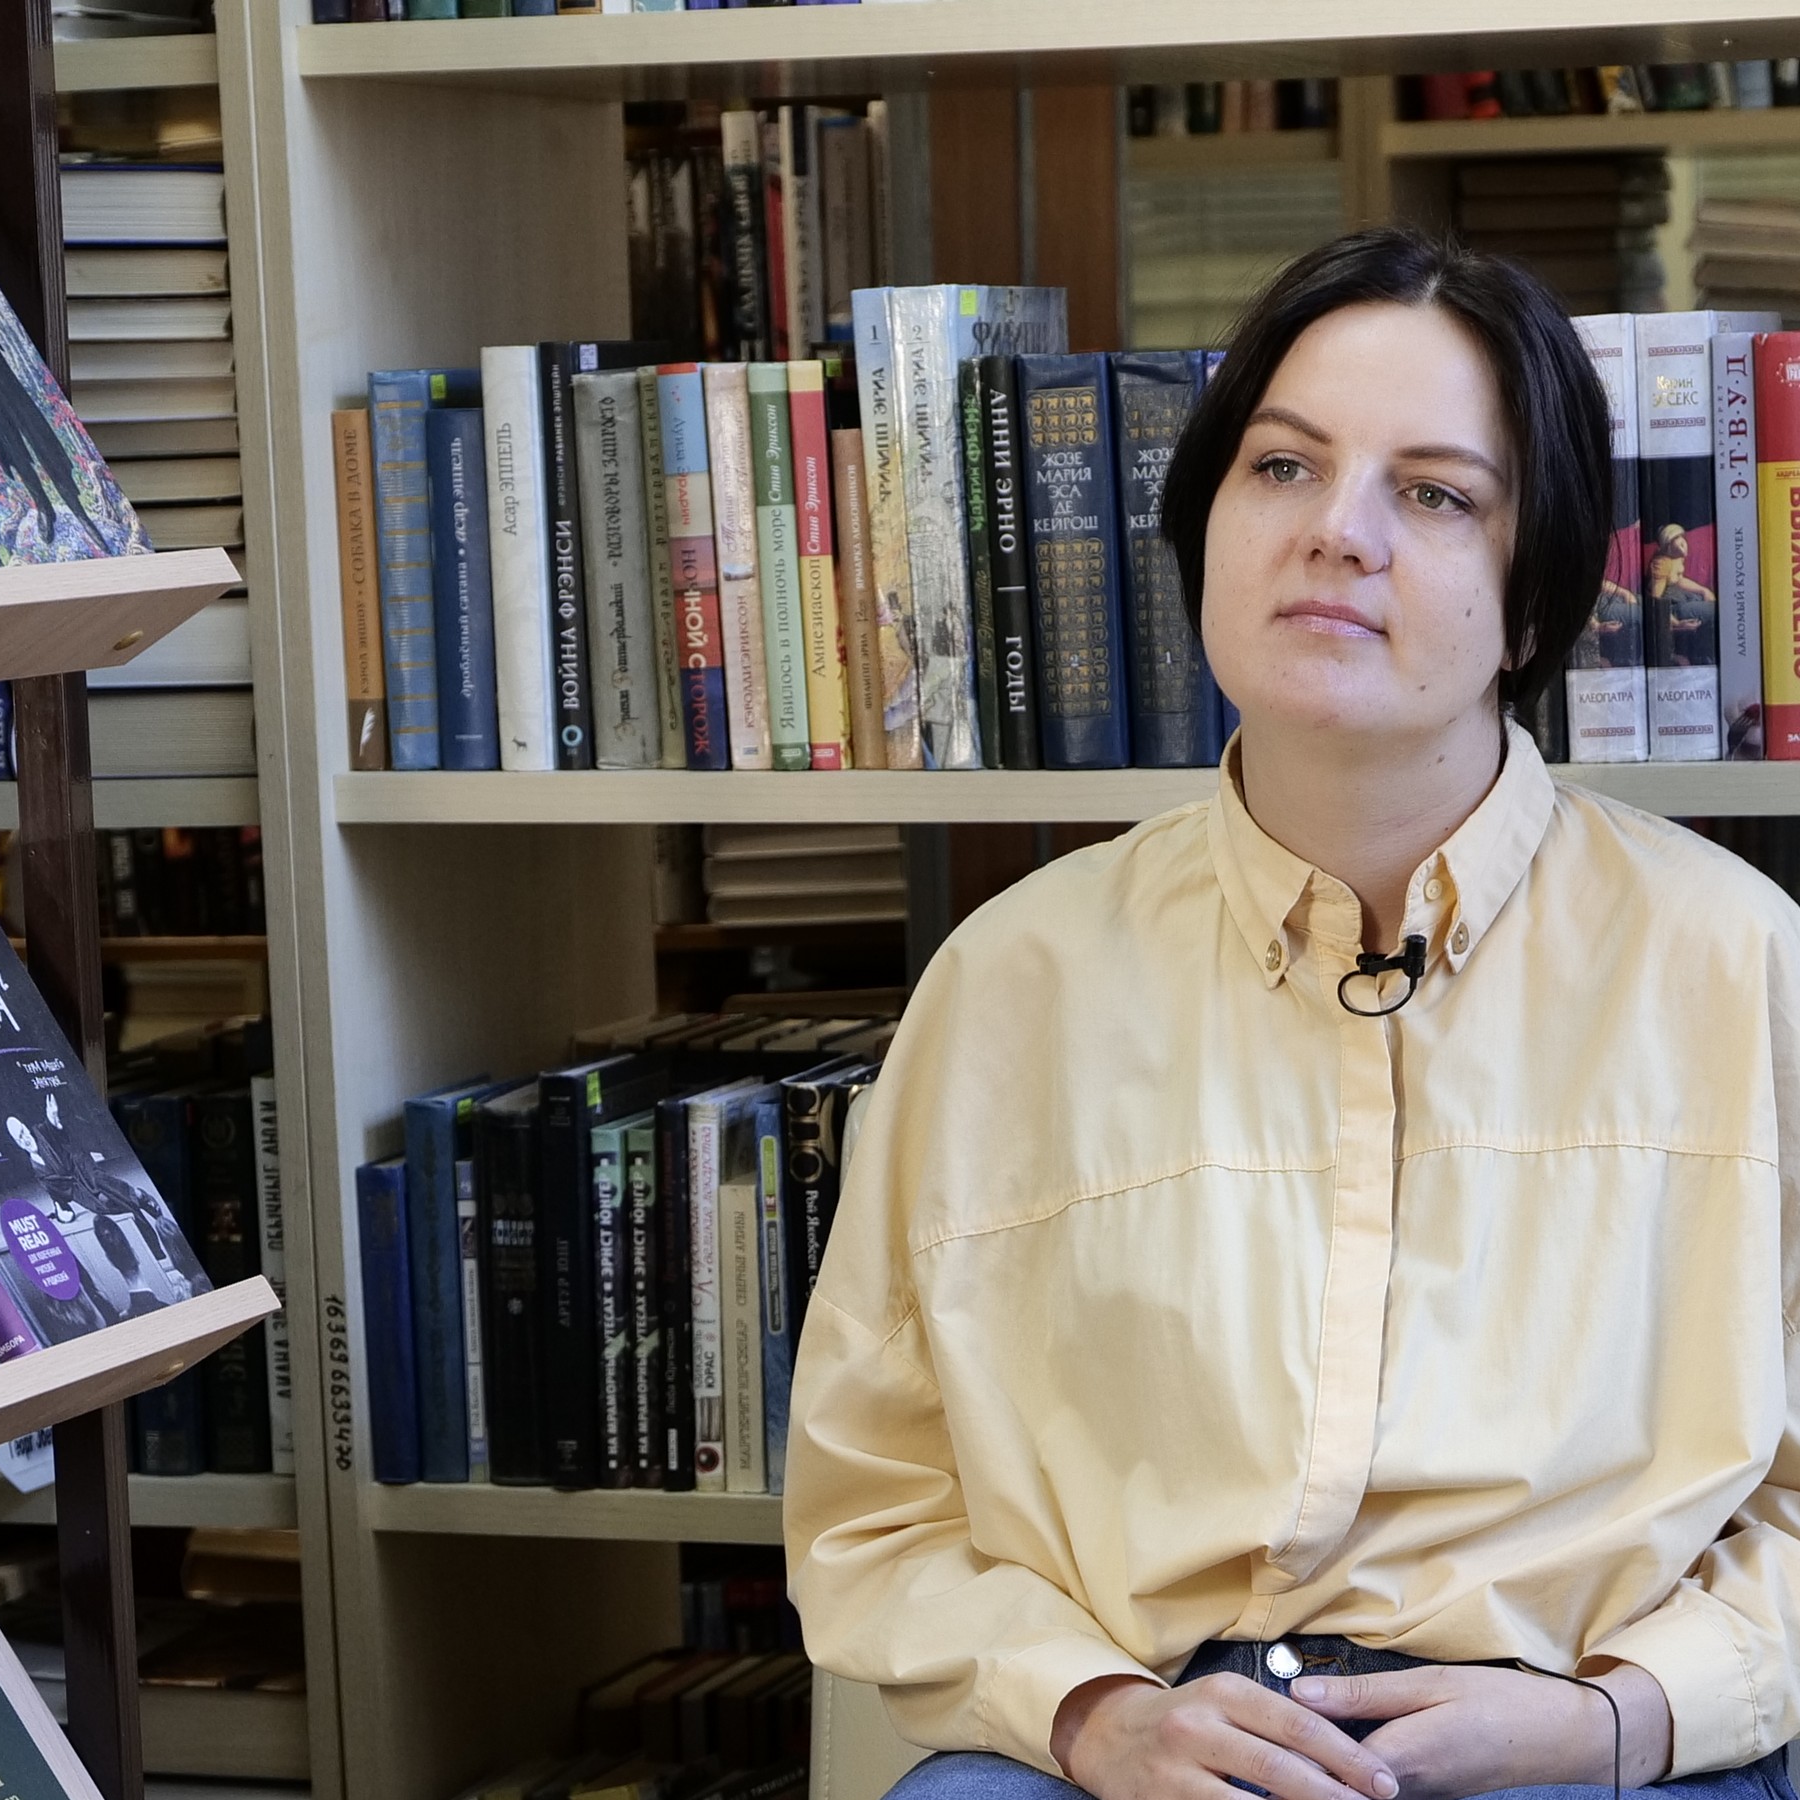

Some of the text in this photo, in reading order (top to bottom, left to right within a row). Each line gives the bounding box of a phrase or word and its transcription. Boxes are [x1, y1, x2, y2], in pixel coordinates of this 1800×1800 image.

[1042, 452, 1083, 467] ЖОЗЕ
[1036, 466, 1093, 483] МАРИЯ
[1047, 484, 1082, 499] ЭСА
[502, 495, 518, 537] Асар
[1053, 501, 1078, 516] ДЕ
[1033, 512, 1098, 532] КЕЙРОШ
[346, 508, 364, 583] СОБАКА
[989, 388, 1026, 713] АННИ ЭРНО ГОДЫ
[766, 404, 795, 729] Стив Эриксон Явилось полночь море
[804, 456, 826, 678] Стив Эриксон Амнезиаскоп
[1734, 526, 1747, 657] ЛАКОМЫЙ КУСОЧЕК
[557, 519, 581, 711] ВОЙНА ФРЭНСИ
[1579, 688, 1634, 704] КЛЕОПАТРА
[1657, 686, 1712, 702] КЛЕОПАТРА
[8, 1214, 37, 1237] MUST
[17, 1230, 51, 1252] READ
[704, 1351, 715, 1390] ЮРАС
